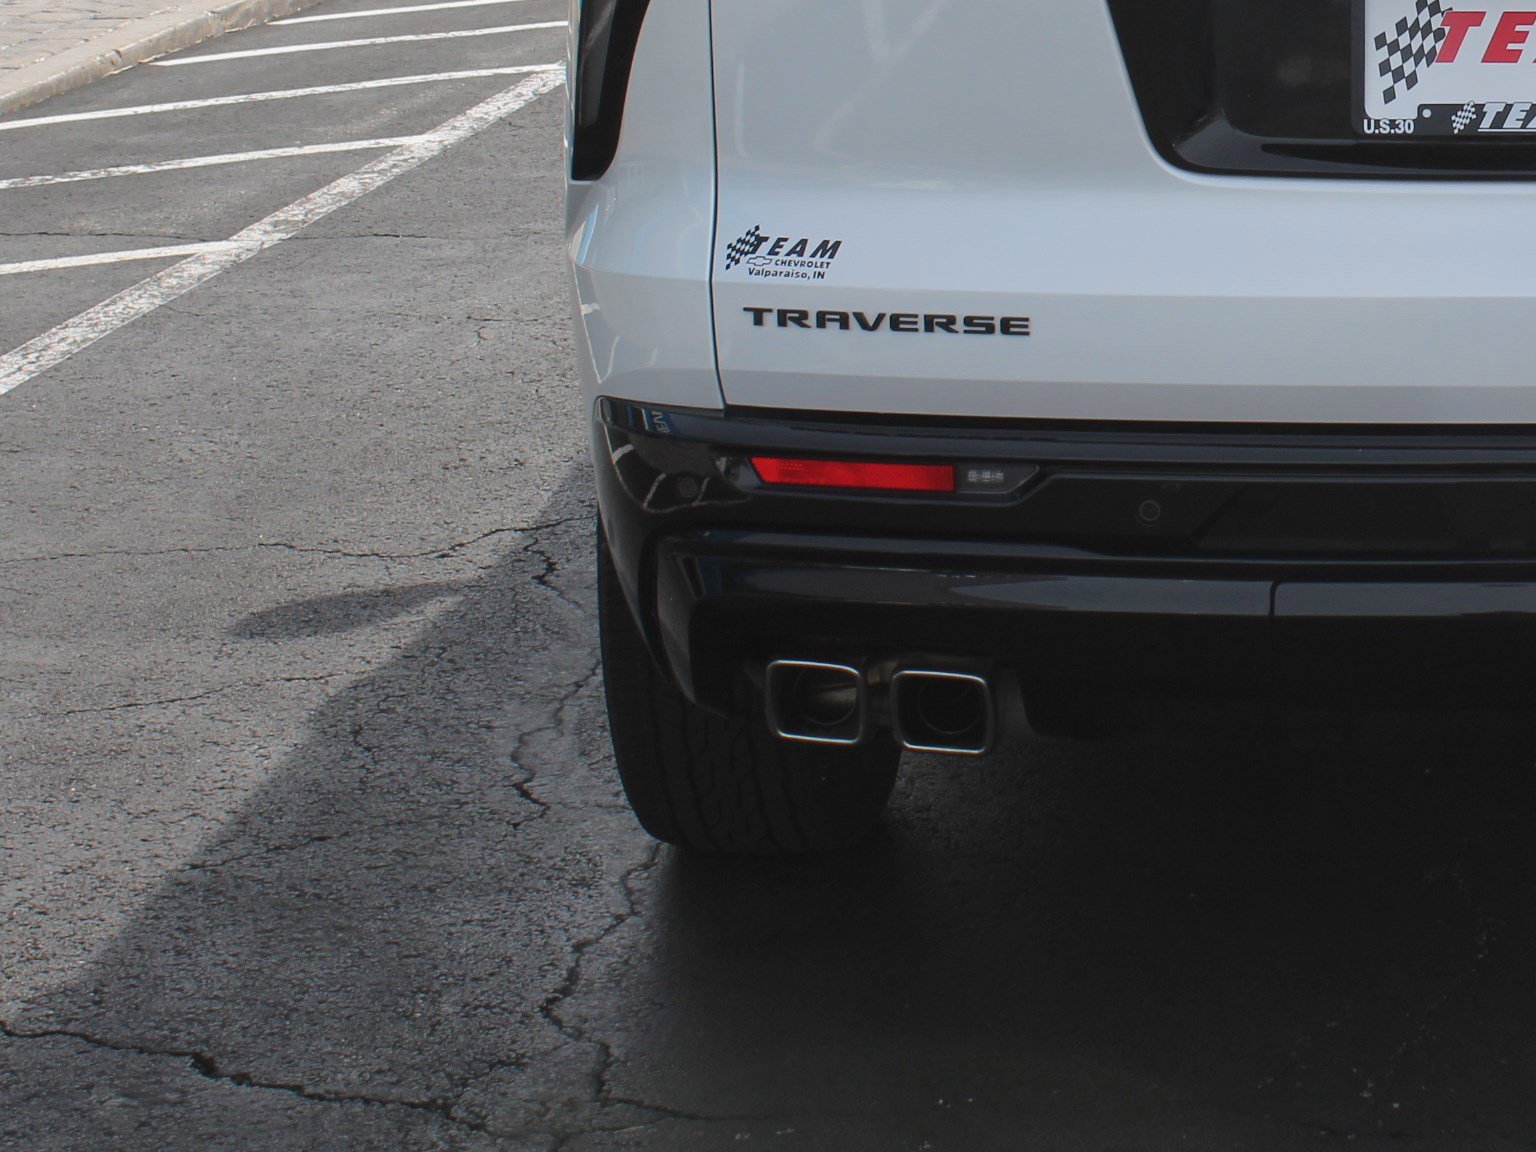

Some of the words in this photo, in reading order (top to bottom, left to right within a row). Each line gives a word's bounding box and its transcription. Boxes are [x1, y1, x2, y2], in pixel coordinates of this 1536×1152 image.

[747, 236, 842, 259] TEAM
[774, 259, 832, 269] CHEVROLET
[748, 267, 811, 280] Valparaiso,
[812, 271, 826, 279] IN
[743, 306, 1030, 336] TRAVERSE
